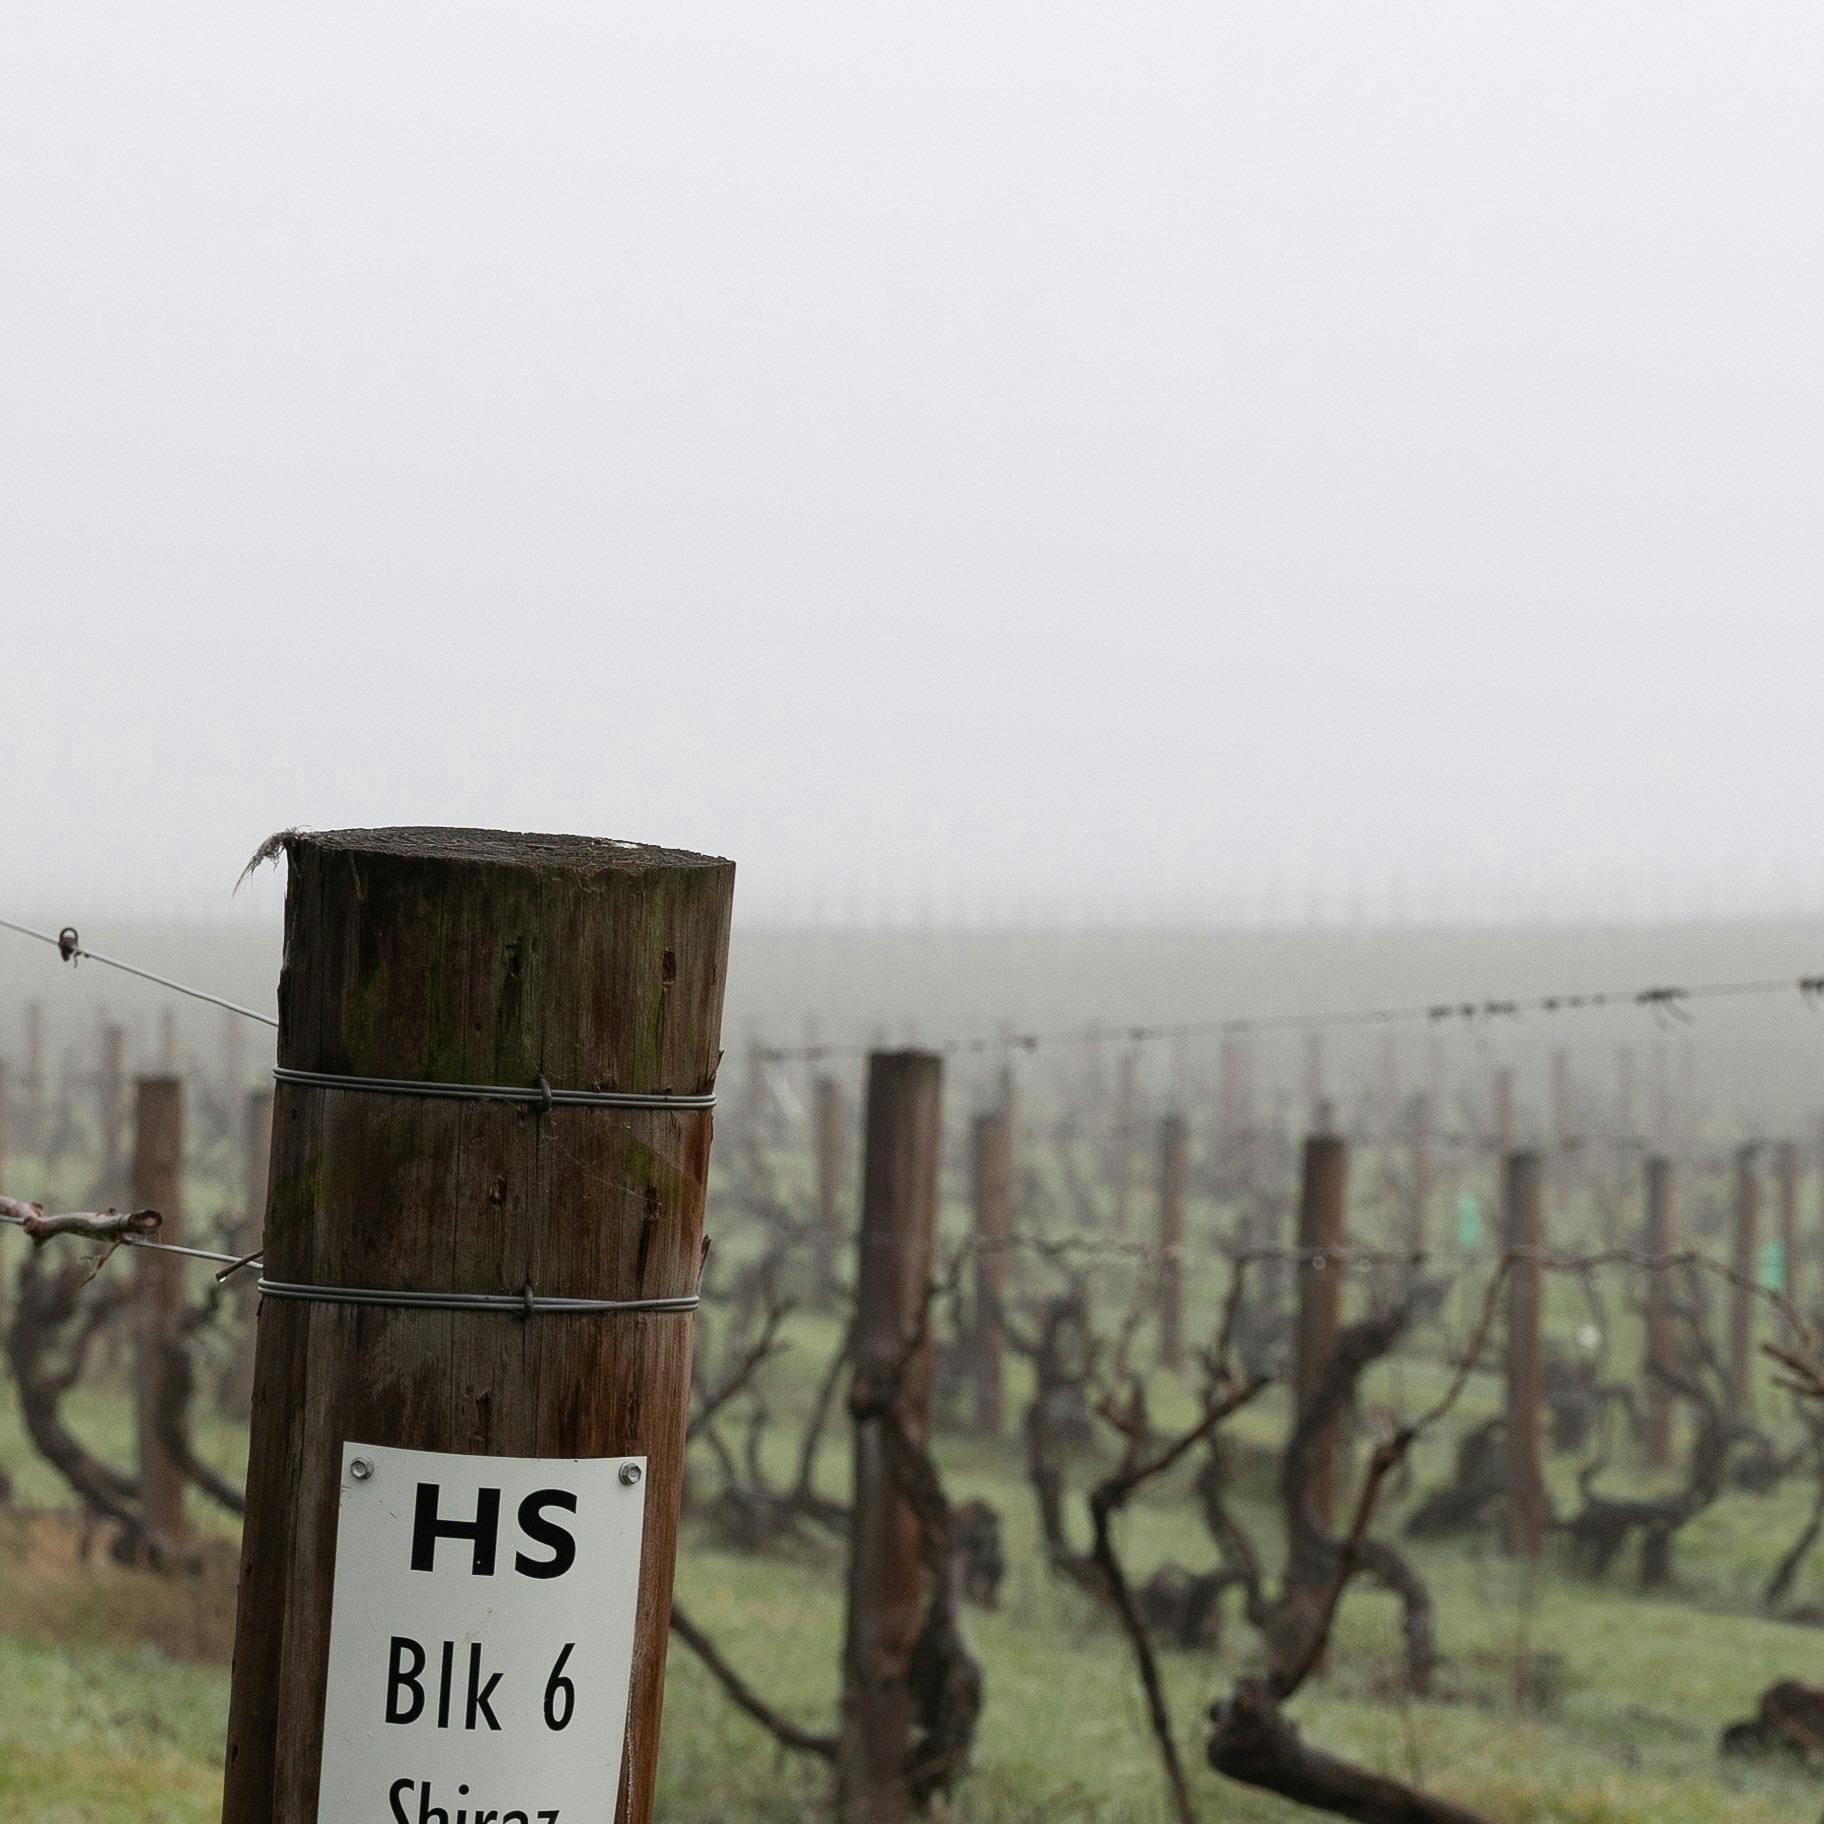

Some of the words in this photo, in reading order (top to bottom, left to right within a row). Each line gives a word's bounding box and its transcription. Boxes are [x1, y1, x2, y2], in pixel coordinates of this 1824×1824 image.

[411, 1483, 577, 1579] HS
[385, 1636, 503, 1730] Blk
[544, 1643, 575, 1731] 6
